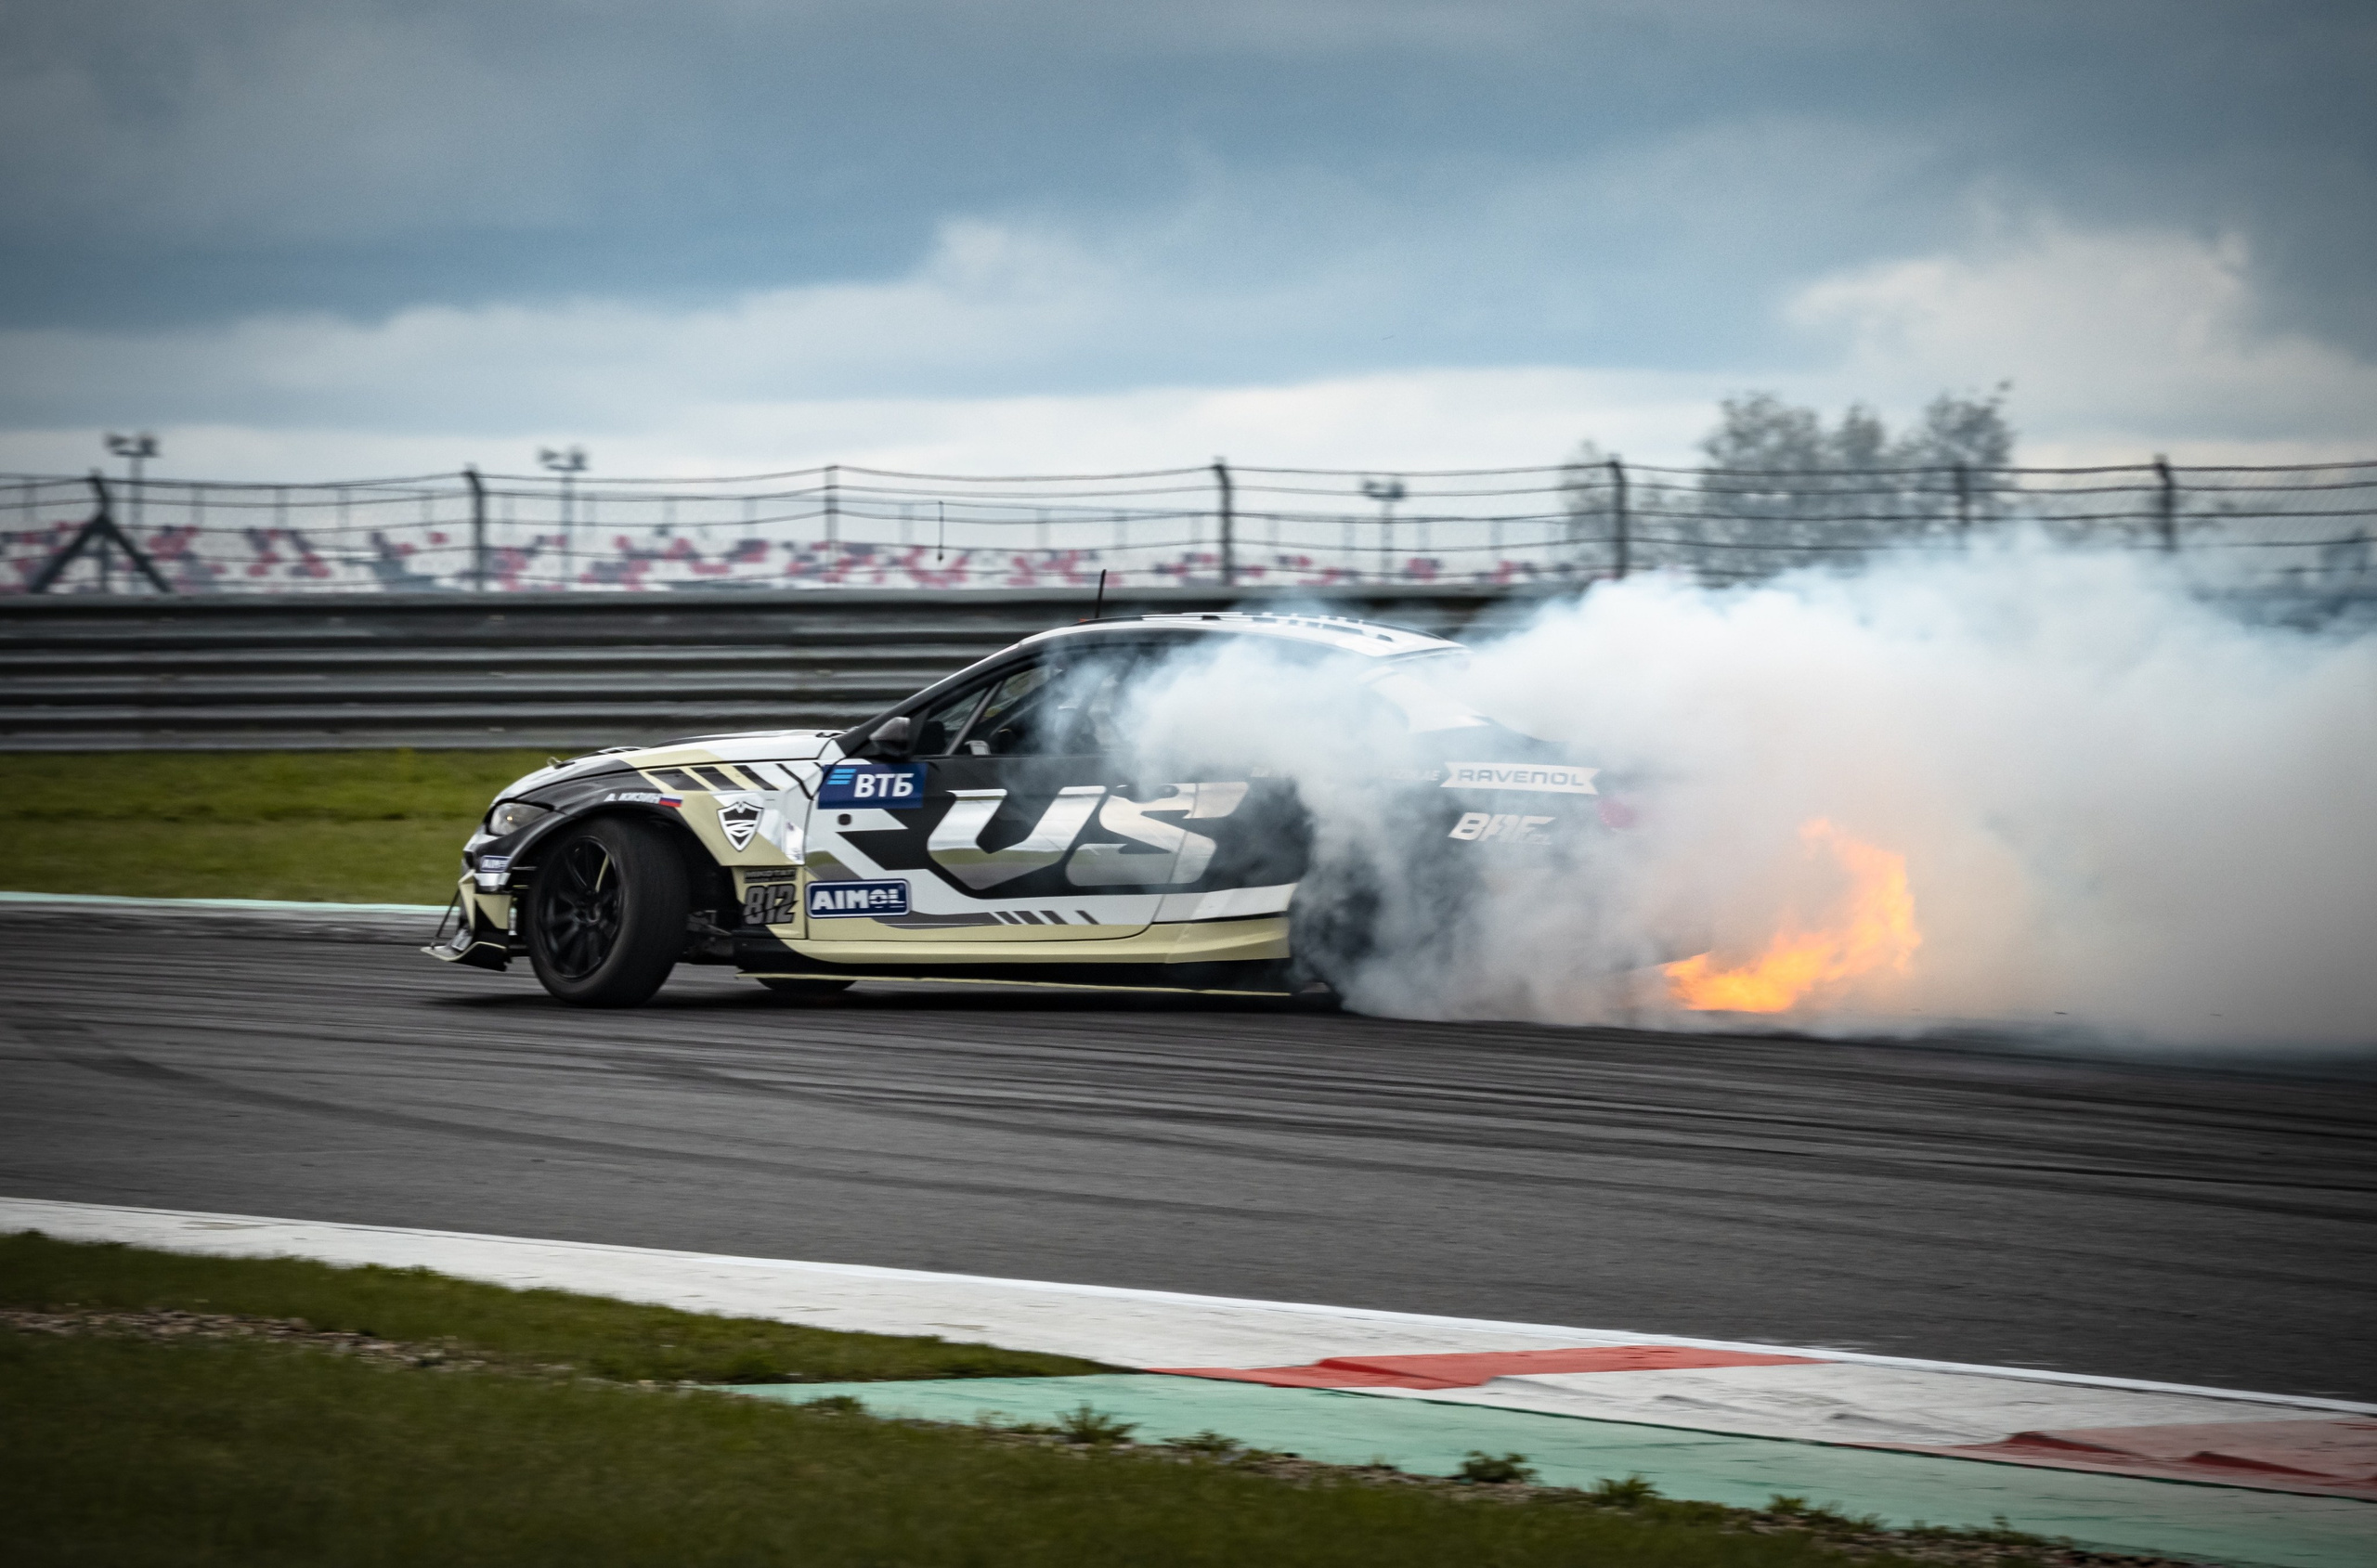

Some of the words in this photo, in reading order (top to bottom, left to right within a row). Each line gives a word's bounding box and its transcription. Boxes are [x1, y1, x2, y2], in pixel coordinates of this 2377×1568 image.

[854, 772, 915, 797] ВТБ
[1458, 769, 1585, 786] RAVENOL
[744, 884, 799, 925] 812
[811, 888, 906, 911] AIMOL
